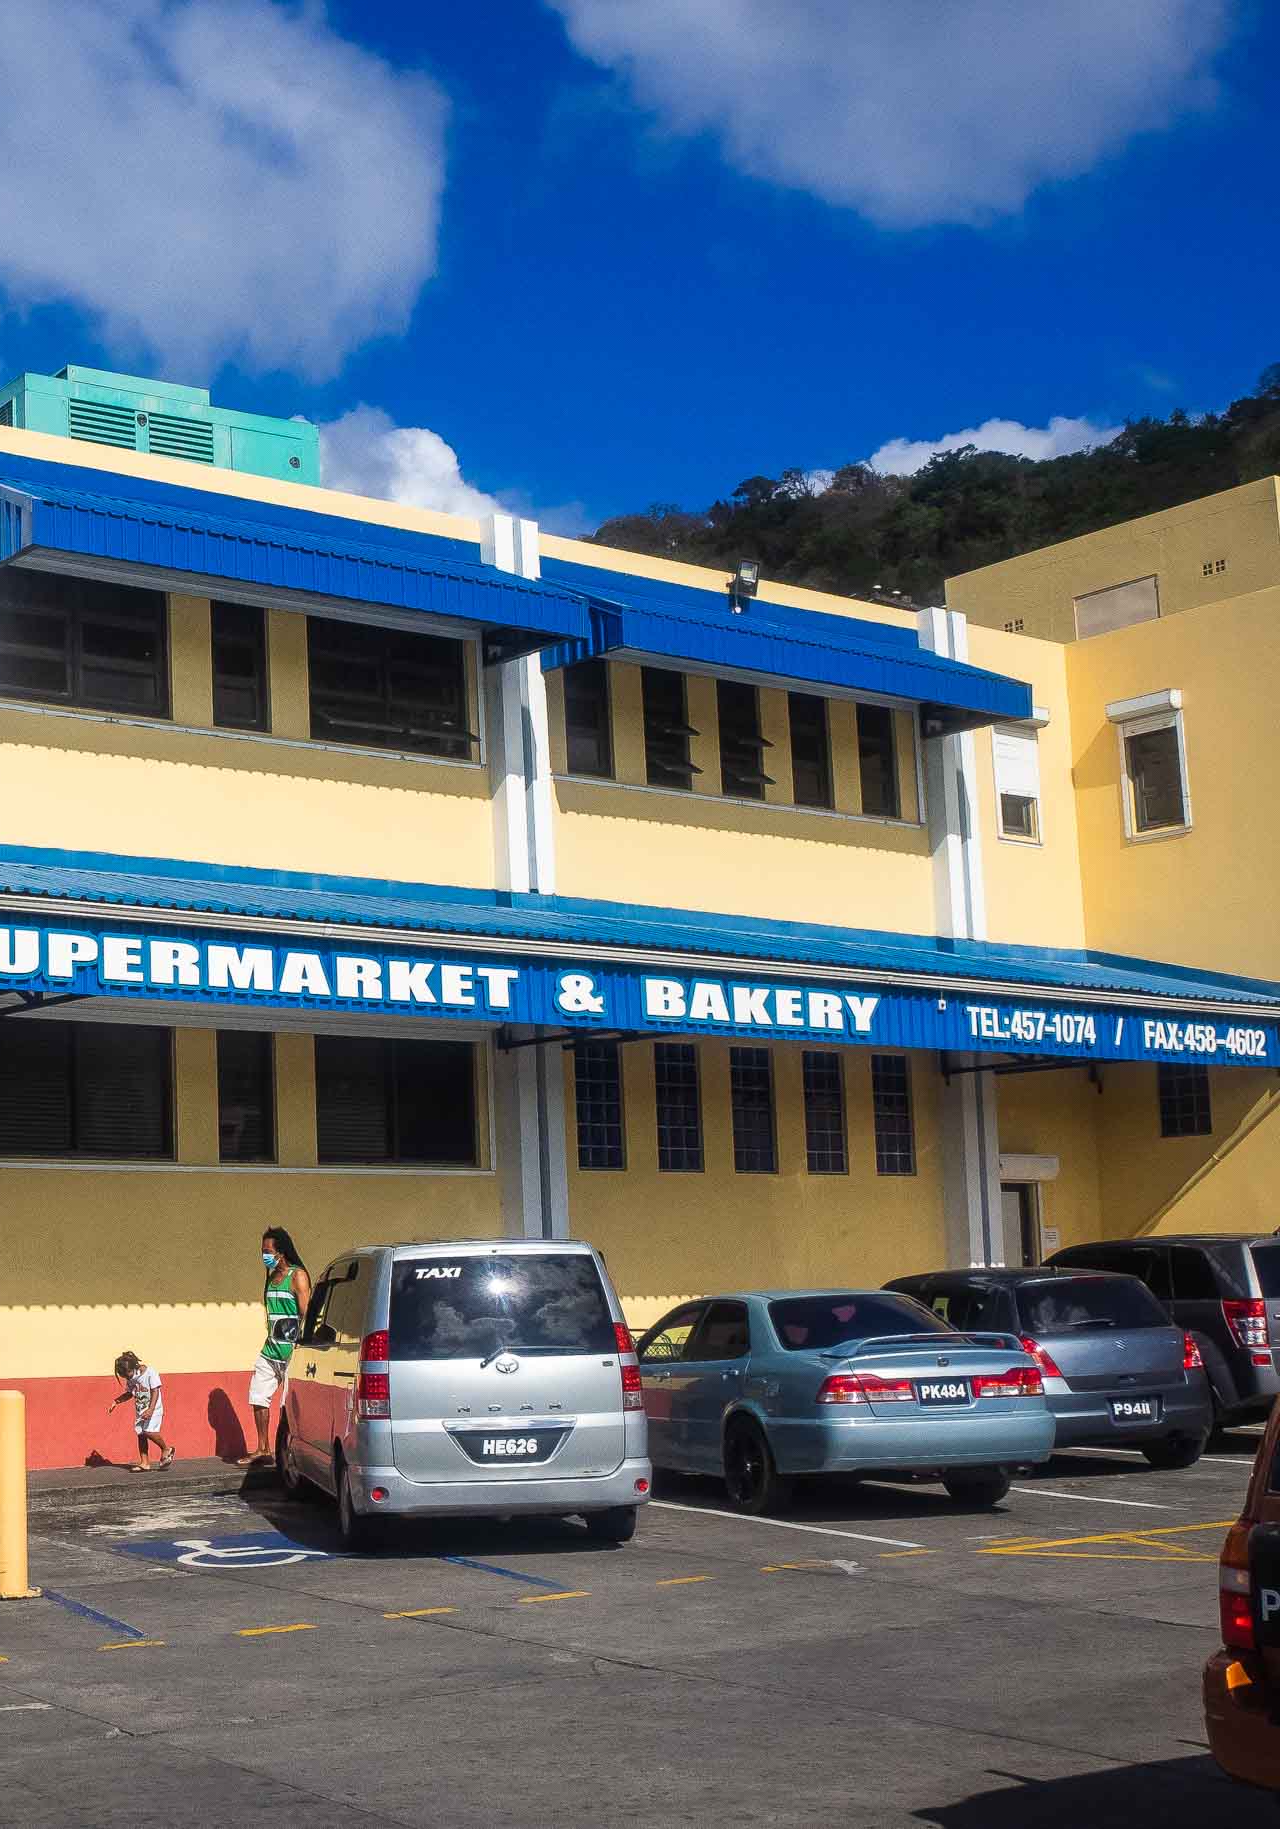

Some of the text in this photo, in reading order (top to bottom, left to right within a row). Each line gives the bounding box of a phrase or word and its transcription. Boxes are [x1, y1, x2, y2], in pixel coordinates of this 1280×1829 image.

[558, 974, 605, 1014] &
[644, 978, 879, 1032] BAKERY
[966, 1006, 1097, 1044] TEL:457-1074
[1143, 1020, 1267, 1056] FAX:458-4602
[416, 1267, 463, 1280] TAXI
[920, 1383, 967, 1400] PK484
[1112, 1402, 1151, 1416] P9411
[482, 1438, 538, 1456] HE626
